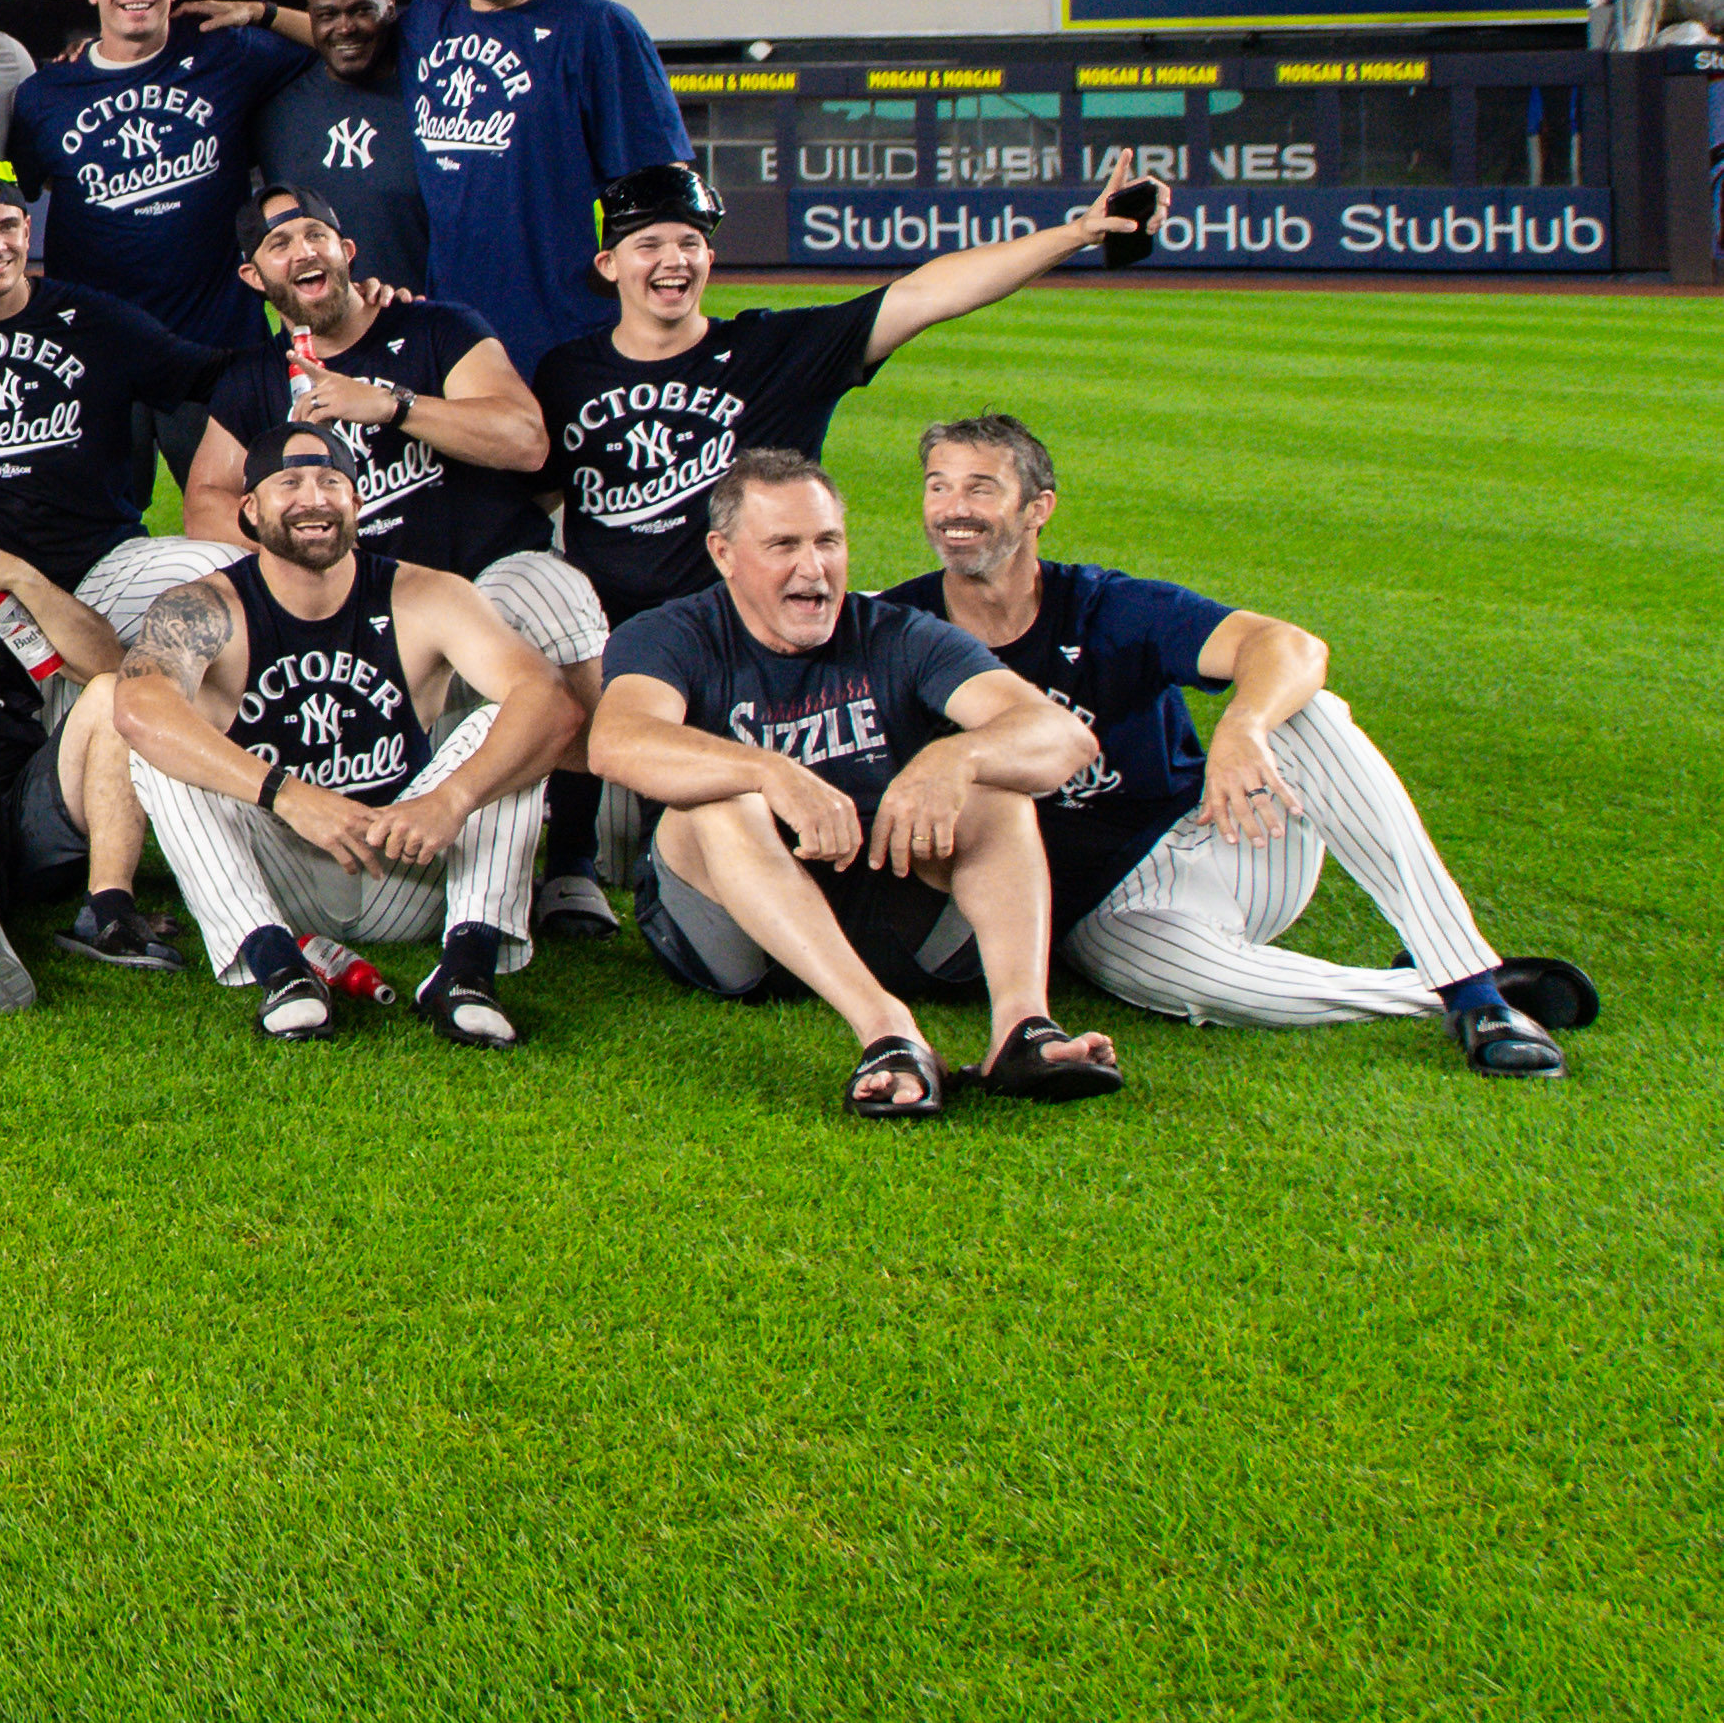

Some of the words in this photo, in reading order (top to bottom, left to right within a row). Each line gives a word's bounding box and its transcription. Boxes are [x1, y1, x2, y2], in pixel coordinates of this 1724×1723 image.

[418, 34, 532, 102] OCTOBER
[740, 72, 796, 90] MORGAN
[869, 70, 925, 88] MORGAN
[944, 69, 1001, 87] MORGAN
[1077, 66, 1138, 86] MORGAN
[1154, 64, 1219, 85] MORGAN
[1277, 62, 1342, 83] MORGAN
[1361, 61, 1426, 82] MORGAN
[61, 85, 213, 155] OCTOBER
[415, 96, 515, 146] Baseball
[76, 135, 219, 207] Baseball
[803, 204, 1037, 252] StubHub
[1340, 205, 1605, 253] StubHub
[564, 381, 746, 451] OCTOBER
[573, 429, 737, 517] Baseball
[239, 650, 403, 725] OCTOBER
